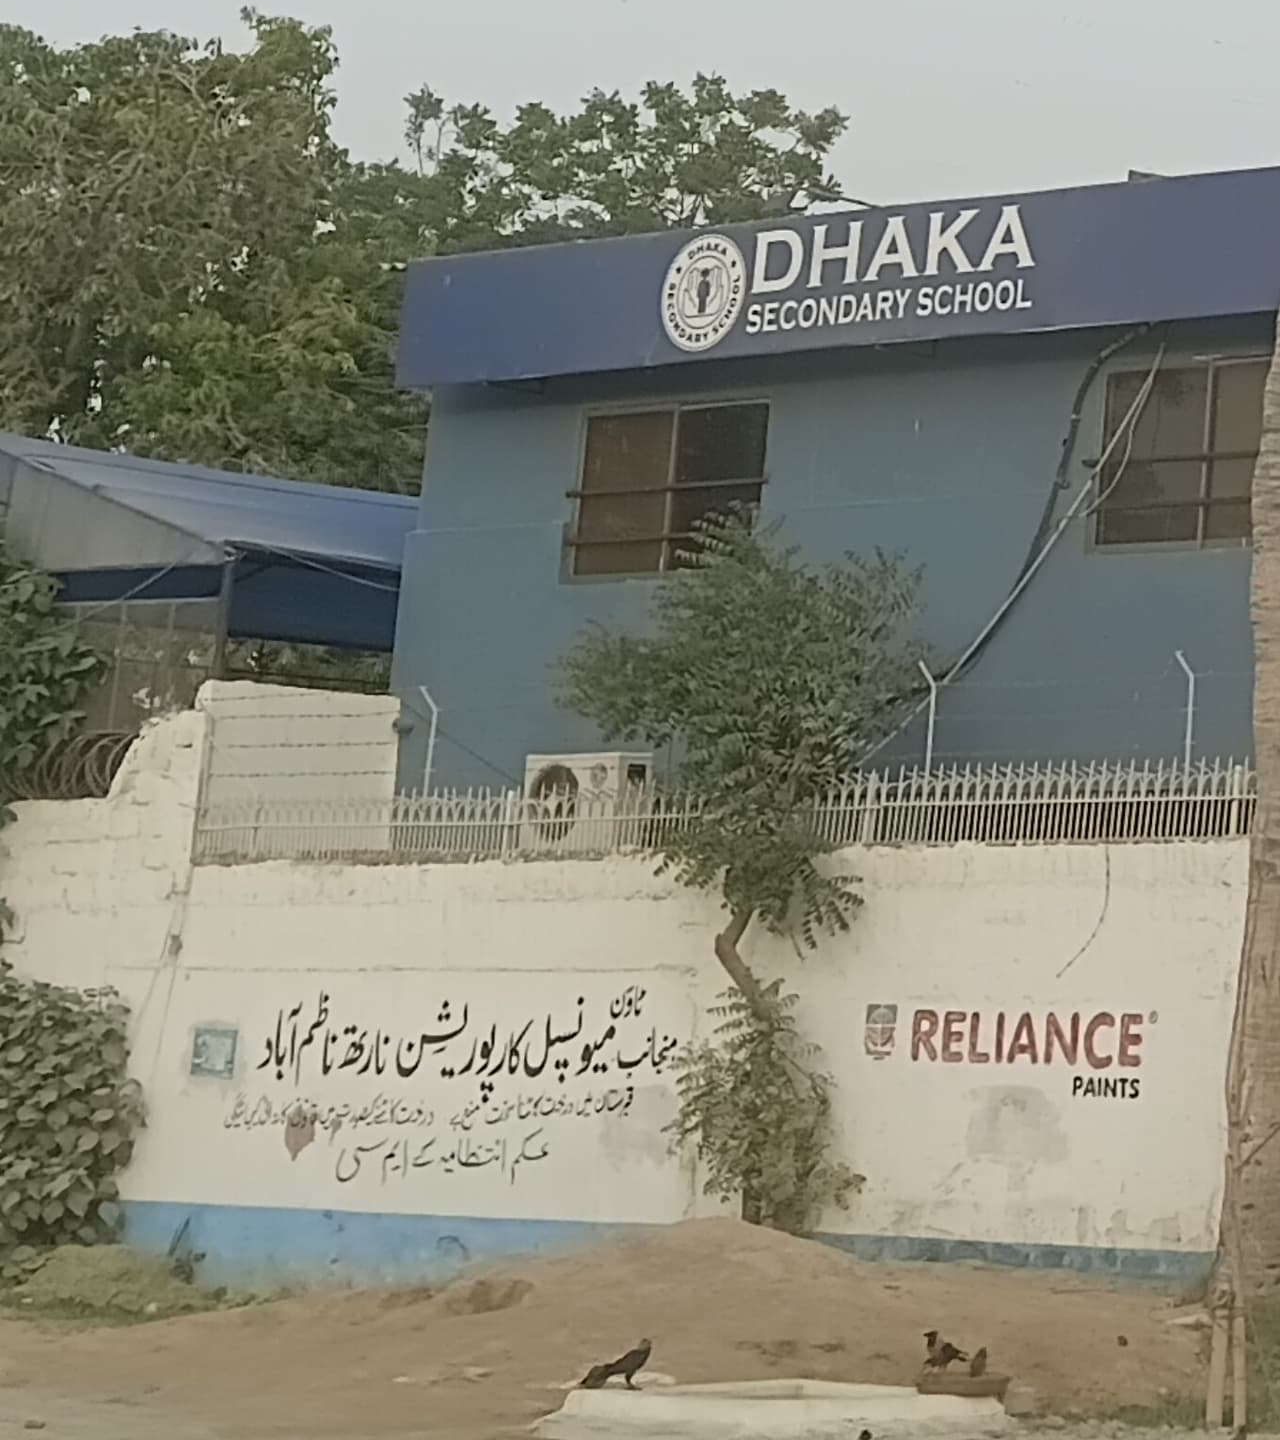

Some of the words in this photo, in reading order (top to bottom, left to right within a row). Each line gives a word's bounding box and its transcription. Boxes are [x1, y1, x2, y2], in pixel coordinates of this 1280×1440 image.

[751, 205, 1035, 294] DHAKA
[745, 289, 913, 334] SECONDARY
[915, 280, 1032, 316] SCHOOL
[256, 1001, 303, 1080] آباد
[337, 1024, 390, 1076] نارتھ
[911, 1009, 1144, 1069] RELIANCE
[1072, 1076, 1141, 1099] PAINTS
